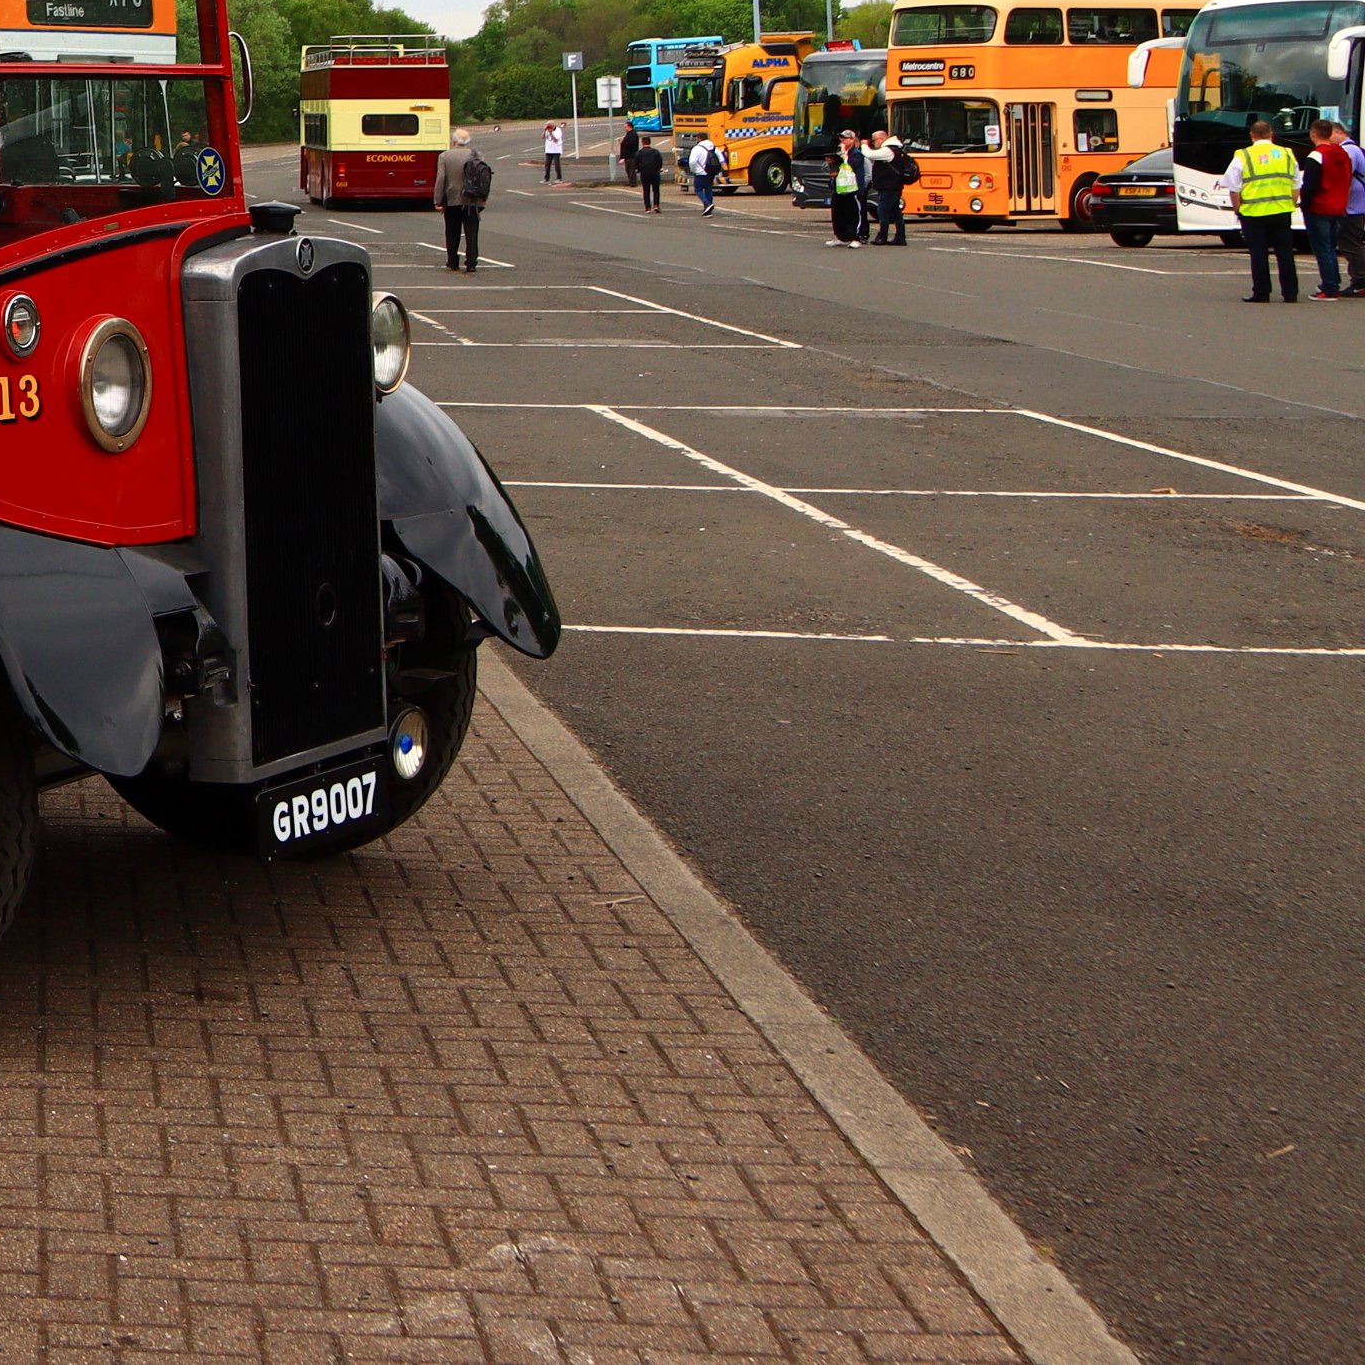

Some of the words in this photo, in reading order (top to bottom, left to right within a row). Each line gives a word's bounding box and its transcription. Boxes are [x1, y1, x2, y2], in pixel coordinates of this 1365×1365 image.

[45, 2, 85, 18] Fastline
[567, 54, 577, 68] F
[752, 57, 790, 69] ALPHA
[901, 61, 945, 72] Metrocentre
[951, 66, 975, 78] 680
[365, 154, 417, 163] ECONOMIC
[272, 770, 377, 842] GR9007
